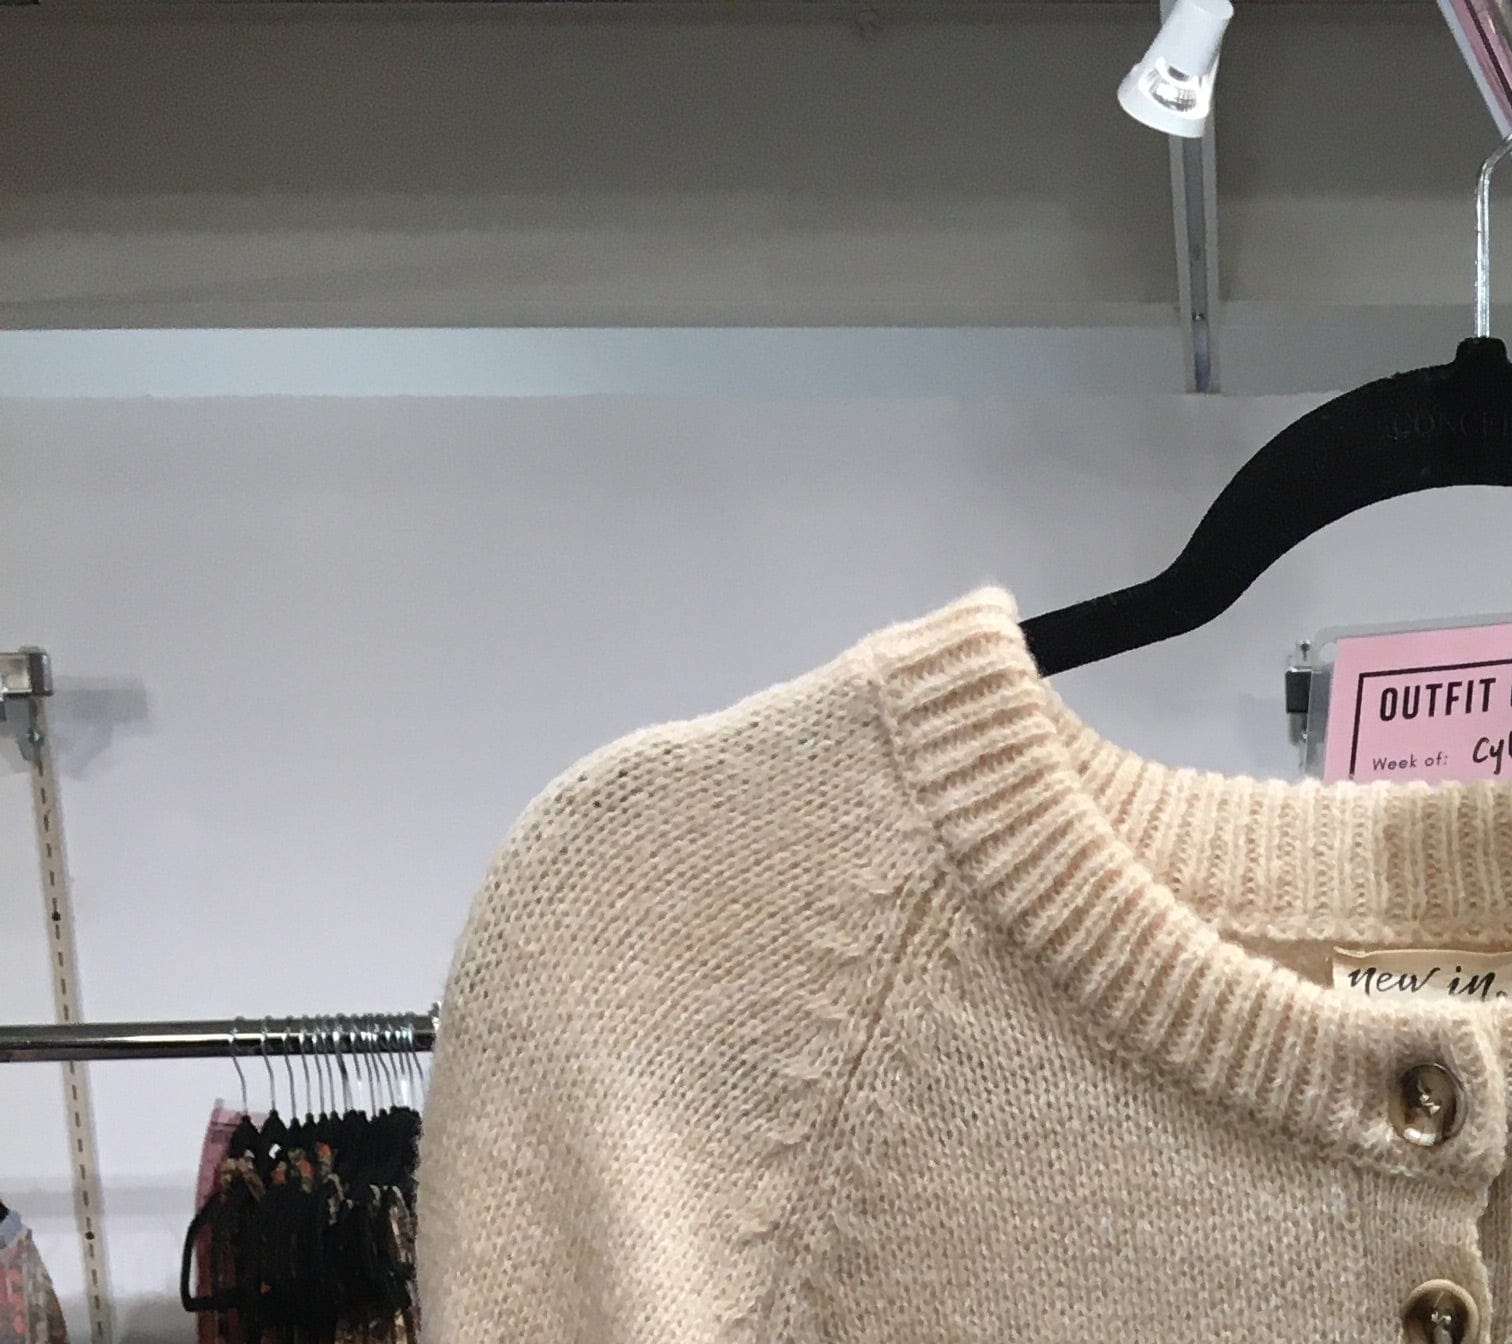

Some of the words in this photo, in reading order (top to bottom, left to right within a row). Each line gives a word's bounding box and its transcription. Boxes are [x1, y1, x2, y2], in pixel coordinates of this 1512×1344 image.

[1379, 677, 1496, 721] OUTFIT
[1373, 753, 1417, 770] Week
[1425, 752, 1448, 766] of:
[1348, 966, 1441, 996] new
